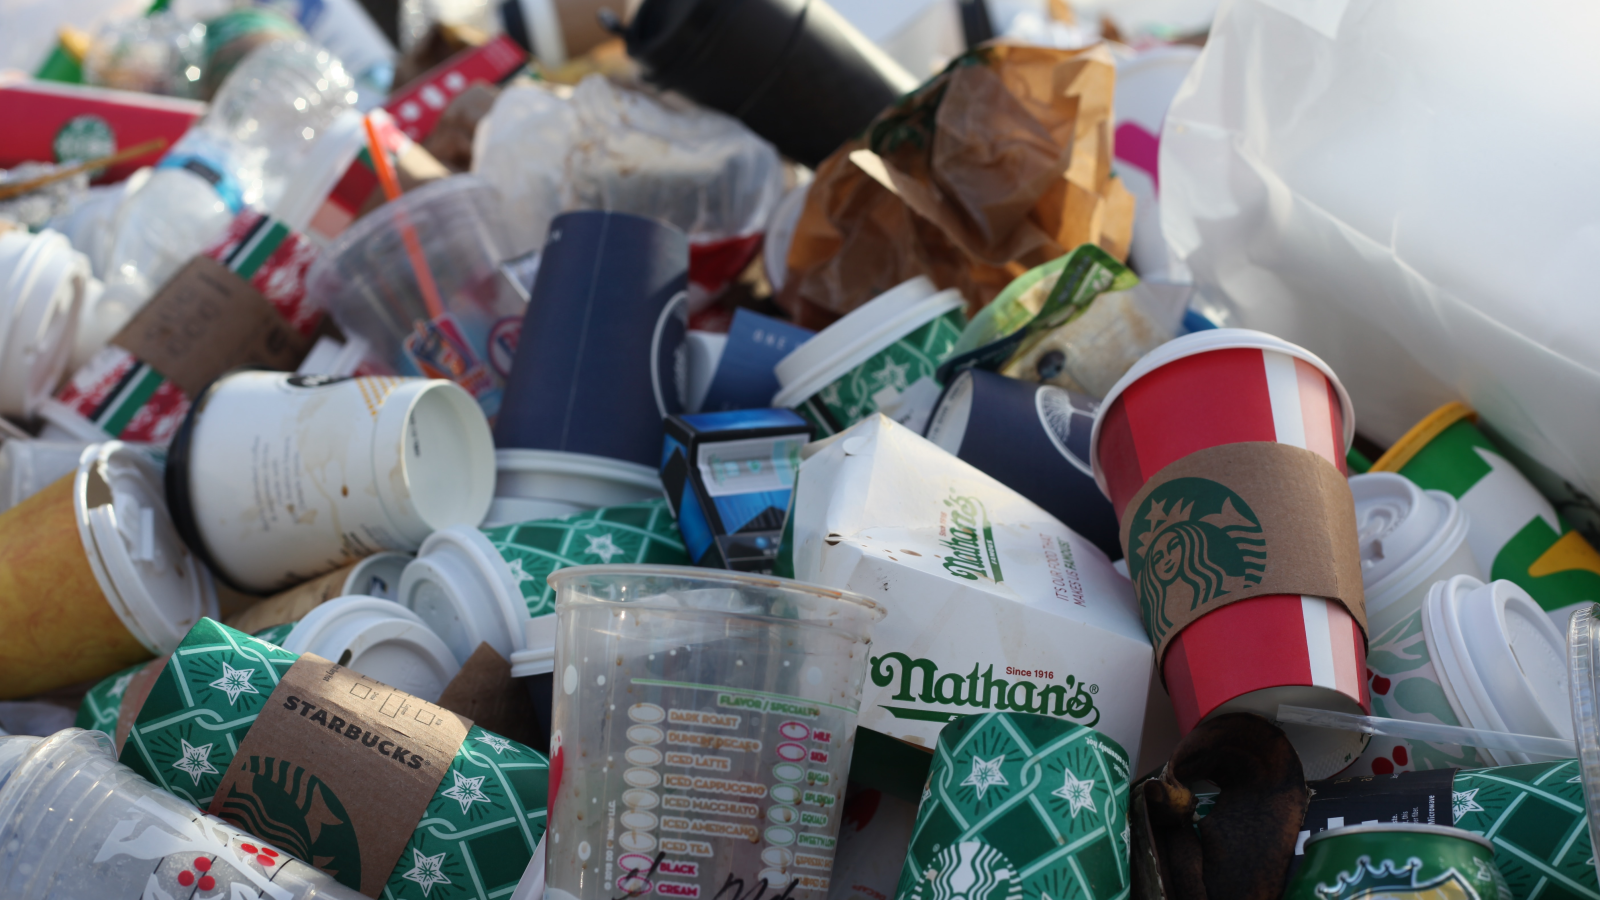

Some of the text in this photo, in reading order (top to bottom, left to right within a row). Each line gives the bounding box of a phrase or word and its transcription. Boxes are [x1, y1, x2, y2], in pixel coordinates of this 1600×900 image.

[1049, 570, 1064, 587] OUR
[1065, 569, 1080, 581] US
[1068, 579, 1087, 607] MAKES
[1006, 666, 1054, 680] Since 1916
[719, 695, 762, 709] FLAVOR
[771, 702, 820, 717] SPECIALTY
[670, 711, 738, 727] DARK ROAST
[667, 754, 729, 769] ICED LATTE
[666, 775, 766, 796] ICED CAPPUCCINO
[664, 797, 757, 816] ICED MACCHIATO
[663, 818, 758, 838] ICED AMERICANO
[661, 840, 711, 855] ICED TEA
[659, 862, 696, 875] BLACK
[657, 884, 698, 896] CREAM
